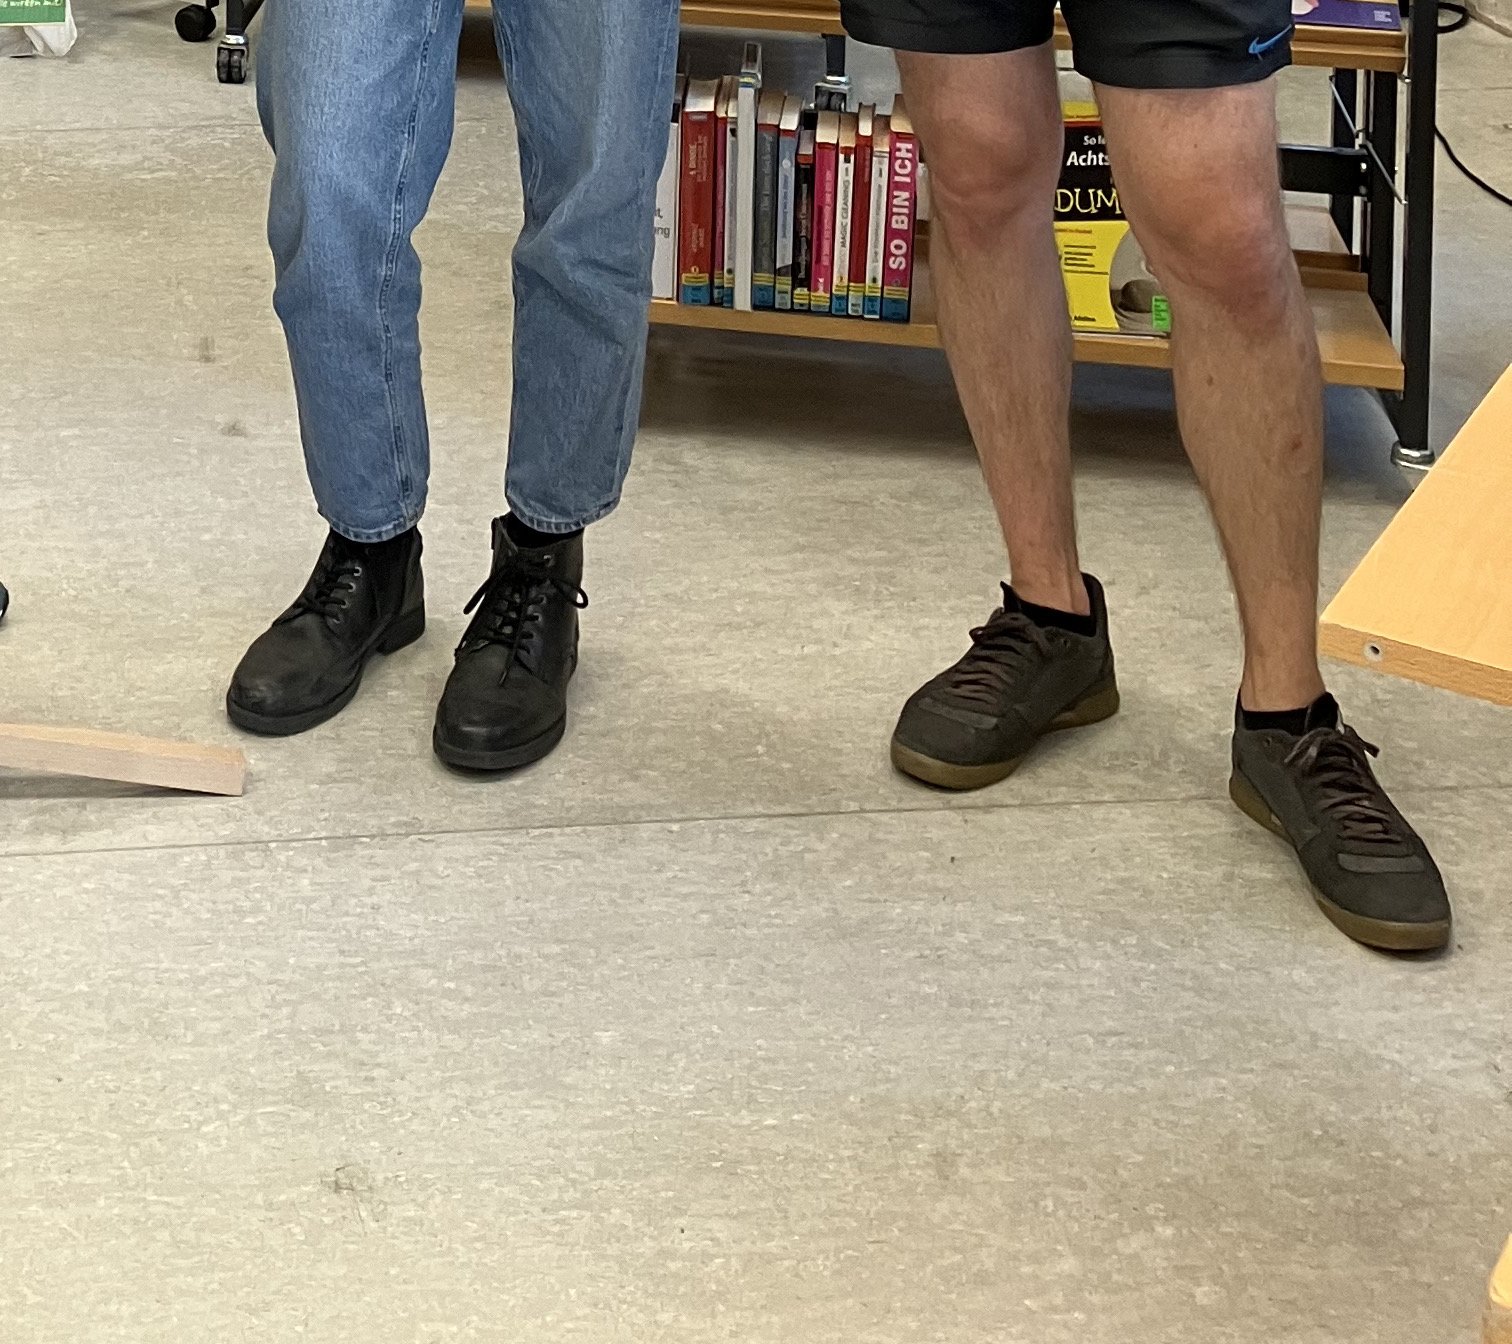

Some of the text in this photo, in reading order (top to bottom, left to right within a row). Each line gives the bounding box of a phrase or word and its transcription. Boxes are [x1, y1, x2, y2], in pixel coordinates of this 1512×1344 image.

[1066, 150, 1110, 167] Achts
[889, 143, 913, 270] SO BIN ICH
[1054, 188, 1122, 214] DUM
[840, 222, 849, 249] MAGIC
